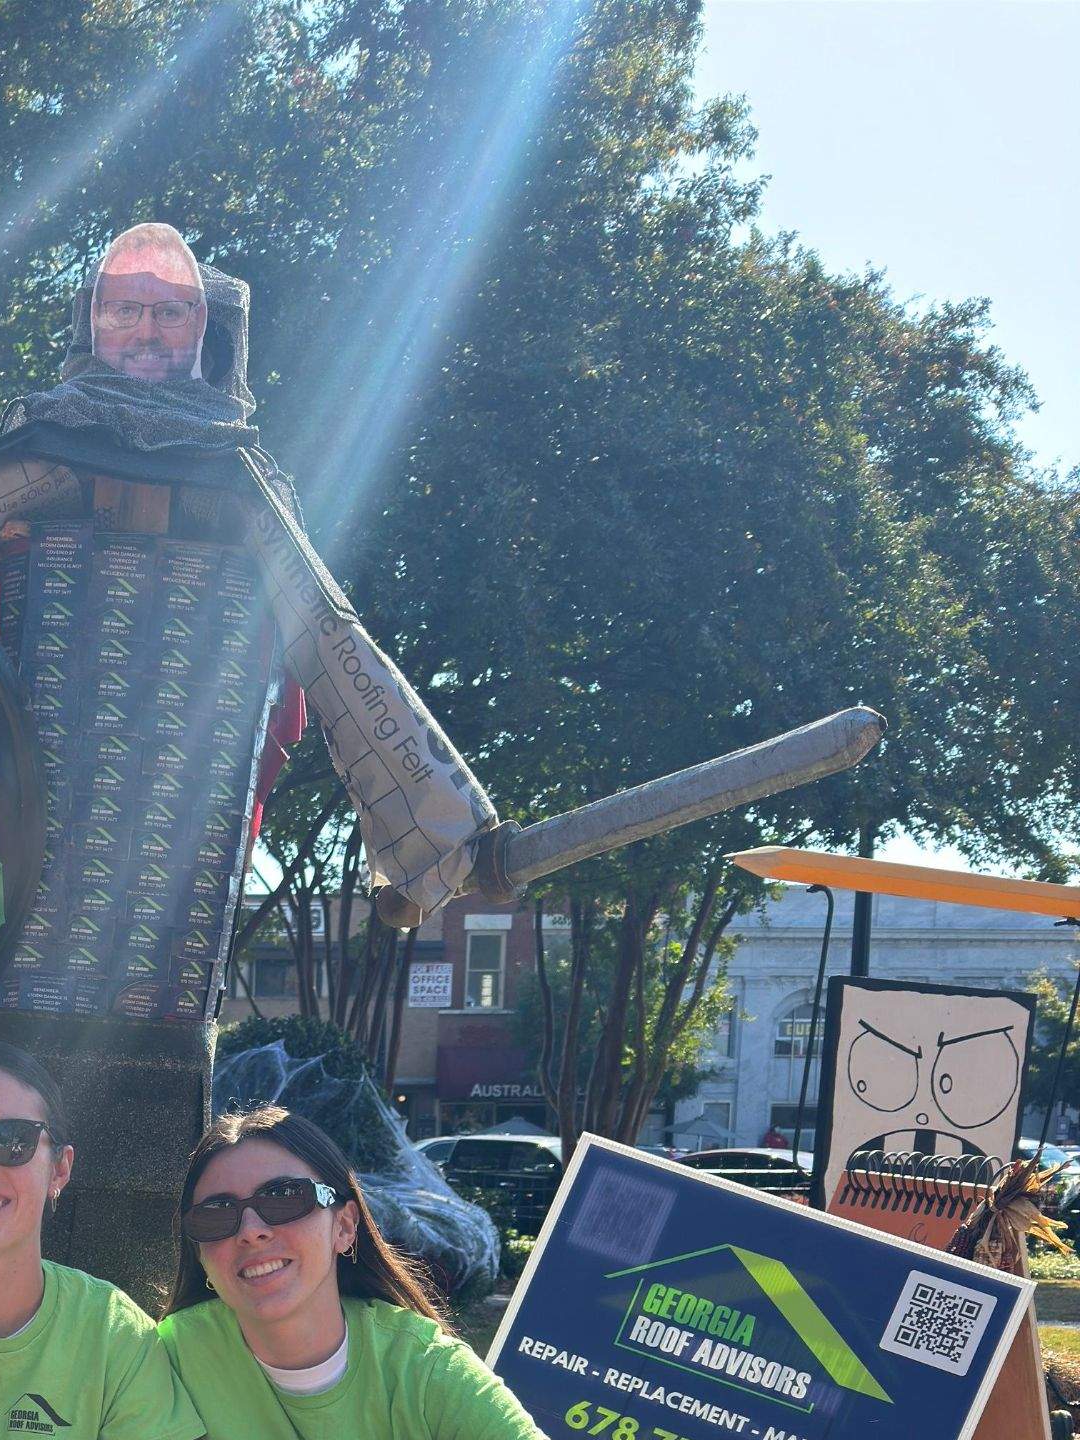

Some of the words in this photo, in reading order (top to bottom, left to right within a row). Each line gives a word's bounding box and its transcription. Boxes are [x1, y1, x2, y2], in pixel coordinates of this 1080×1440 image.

[332, 637, 401, 742] Roofing
[391, 734, 434, 784] Felt
[412, 975, 450, 984] OFFICE
[413, 985, 448, 994] SPACE
[470, 1084, 545, 1098] AUSTRAL
[642, 1282, 758, 1348] GEORGIA
[628, 1314, 692, 1356] ROOF
[691, 1337, 813, 1400] ADVISORS
[517, 1336, 589, 1377] REPAIR
[603, 1367, 750, 1433] REPLACEMENT
[10, 1410, 40, 1422] GEORGIA
[9, 1420, 24, 1430] ROOF
[26, 1421, 54, 1433] ADVISORS
